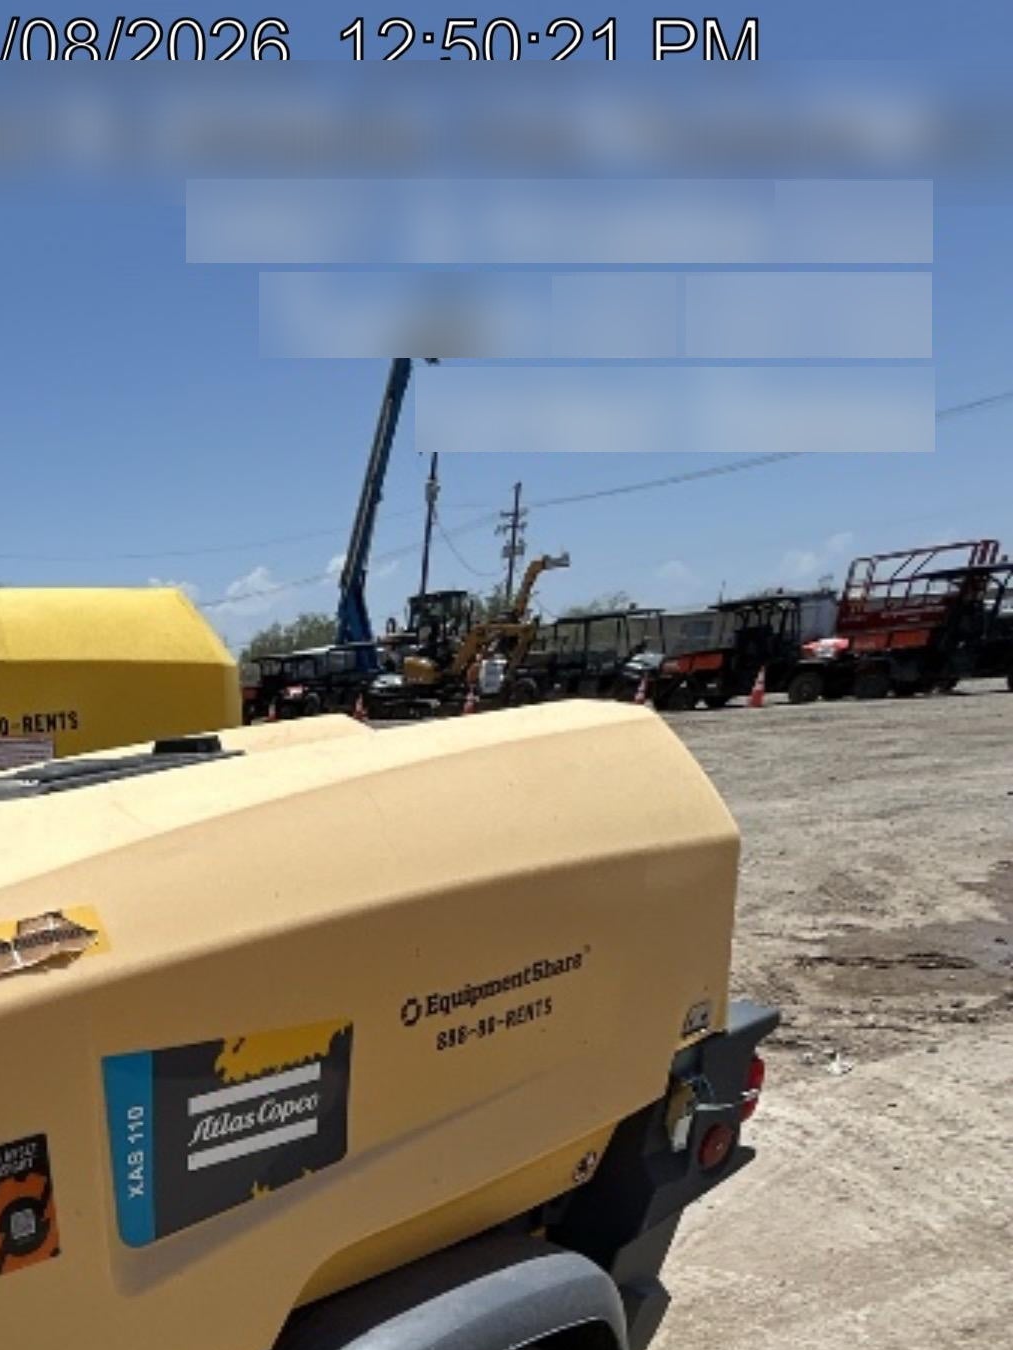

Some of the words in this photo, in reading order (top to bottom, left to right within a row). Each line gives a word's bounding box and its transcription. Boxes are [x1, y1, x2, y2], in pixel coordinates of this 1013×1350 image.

[127, 1106, 144, 1144] 110
[188, 1111, 256, 1147] Atlas
[256, 1092, 319, 1125] Copco
